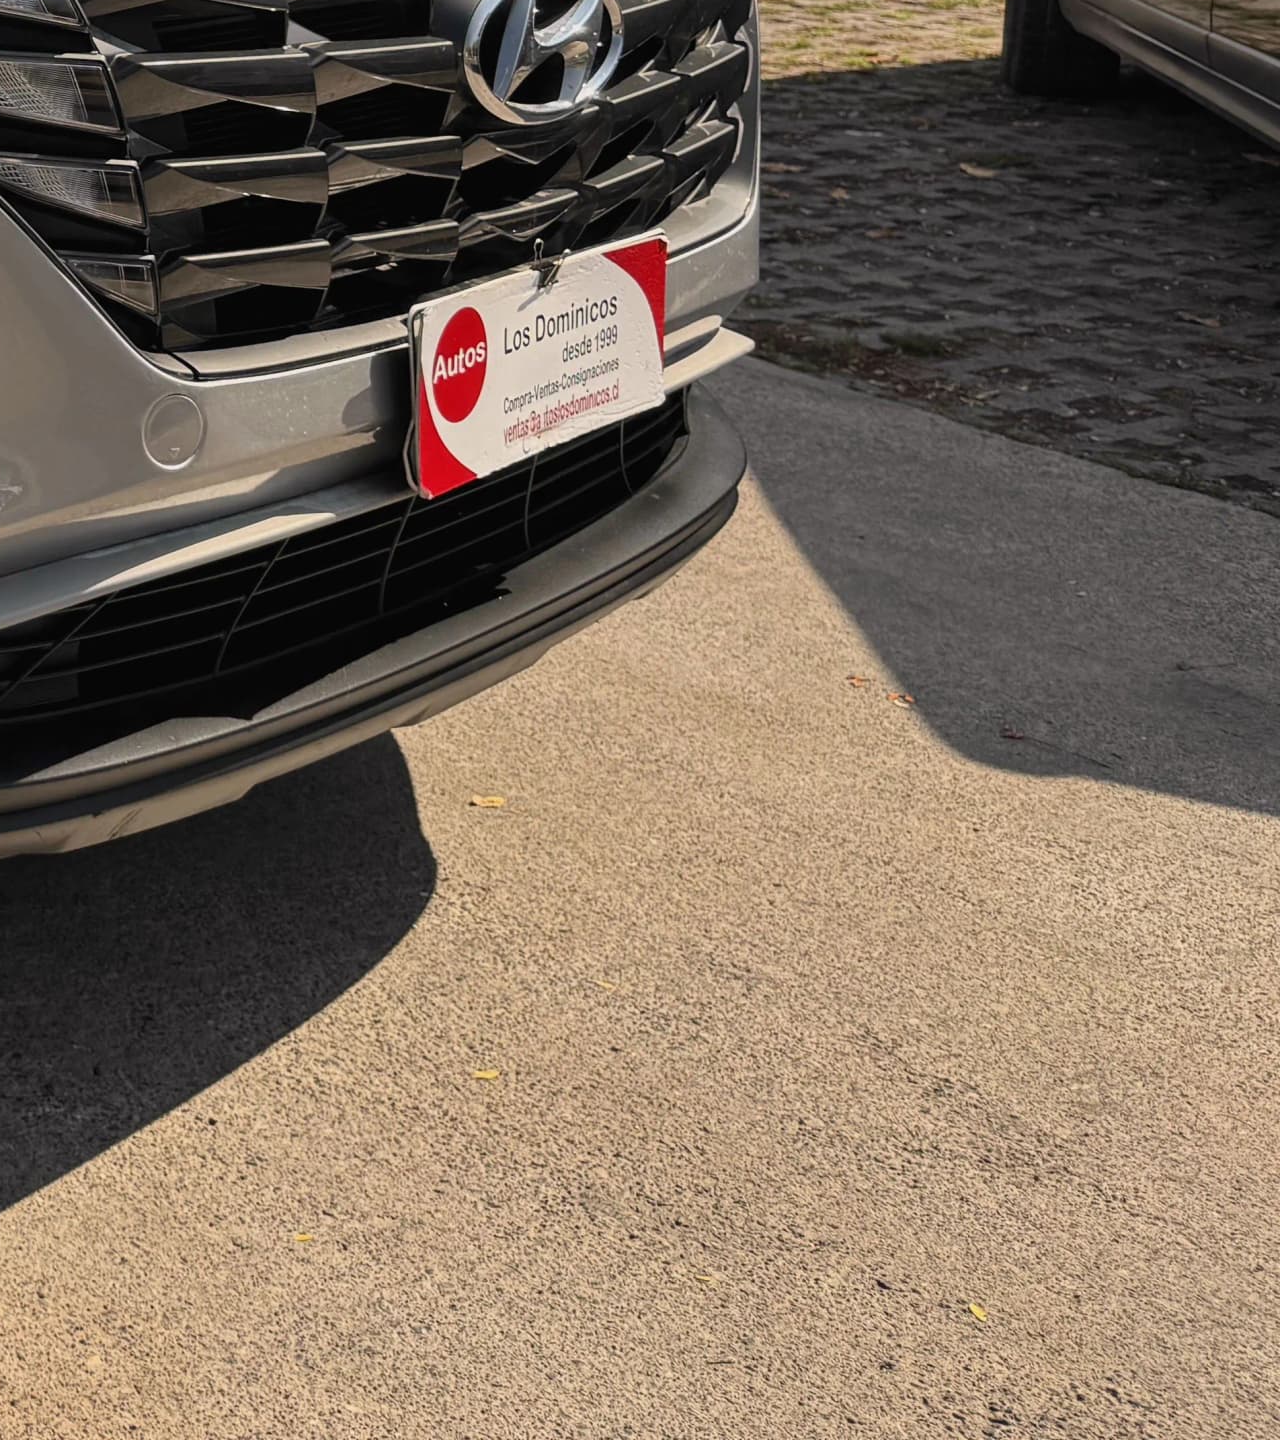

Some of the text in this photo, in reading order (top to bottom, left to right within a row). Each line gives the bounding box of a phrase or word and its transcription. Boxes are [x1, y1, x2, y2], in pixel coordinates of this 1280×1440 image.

[503, 295, 619, 355] Los Dominicos
[562, 324, 618, 363] desde 1999
[432, 341, 487, 385] Autos
